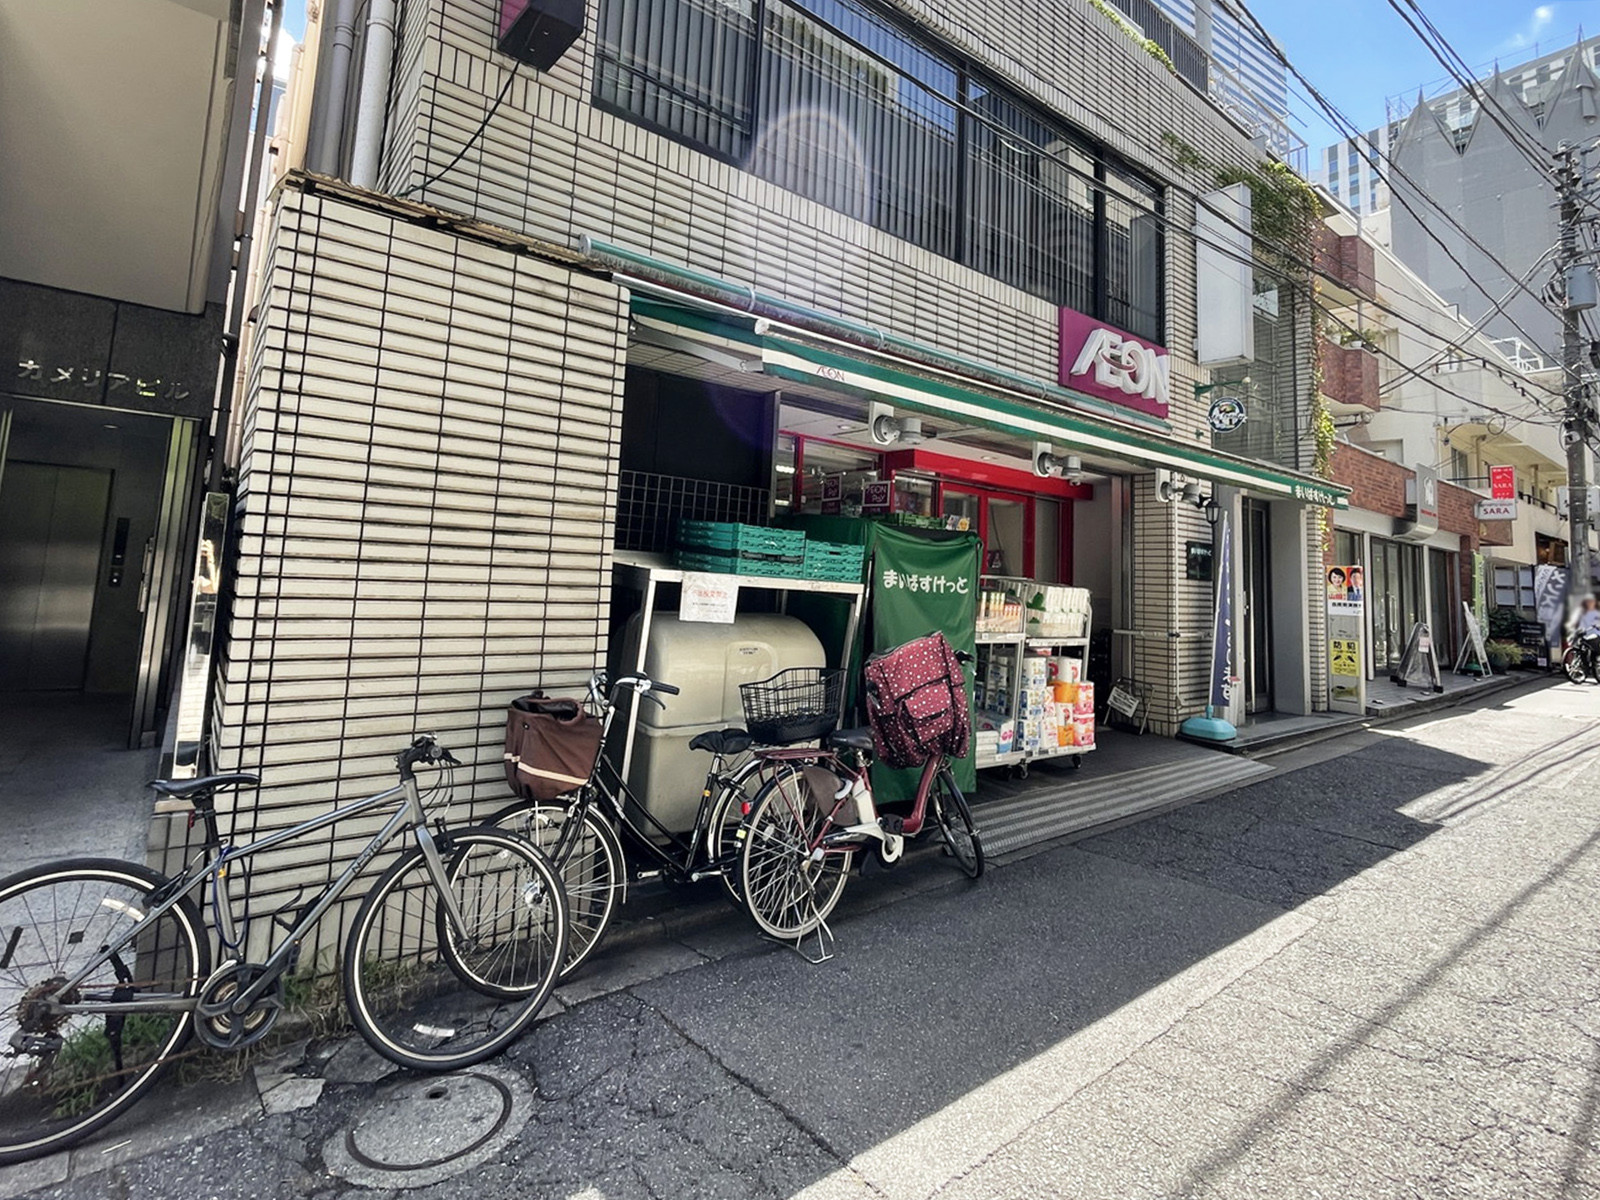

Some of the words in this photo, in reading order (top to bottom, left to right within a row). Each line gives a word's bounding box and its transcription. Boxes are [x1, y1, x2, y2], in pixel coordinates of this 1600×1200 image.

[18, 360, 189, 399] カメリアビル
[1070, 328, 1170, 404] AEON
[1295, 485, 1335, 506] まいばすけっと
[1483, 507, 1510, 515] SARA
[883, 569, 969, 594] まいばすけっと
[351, 838, 382, 874] NESTO
